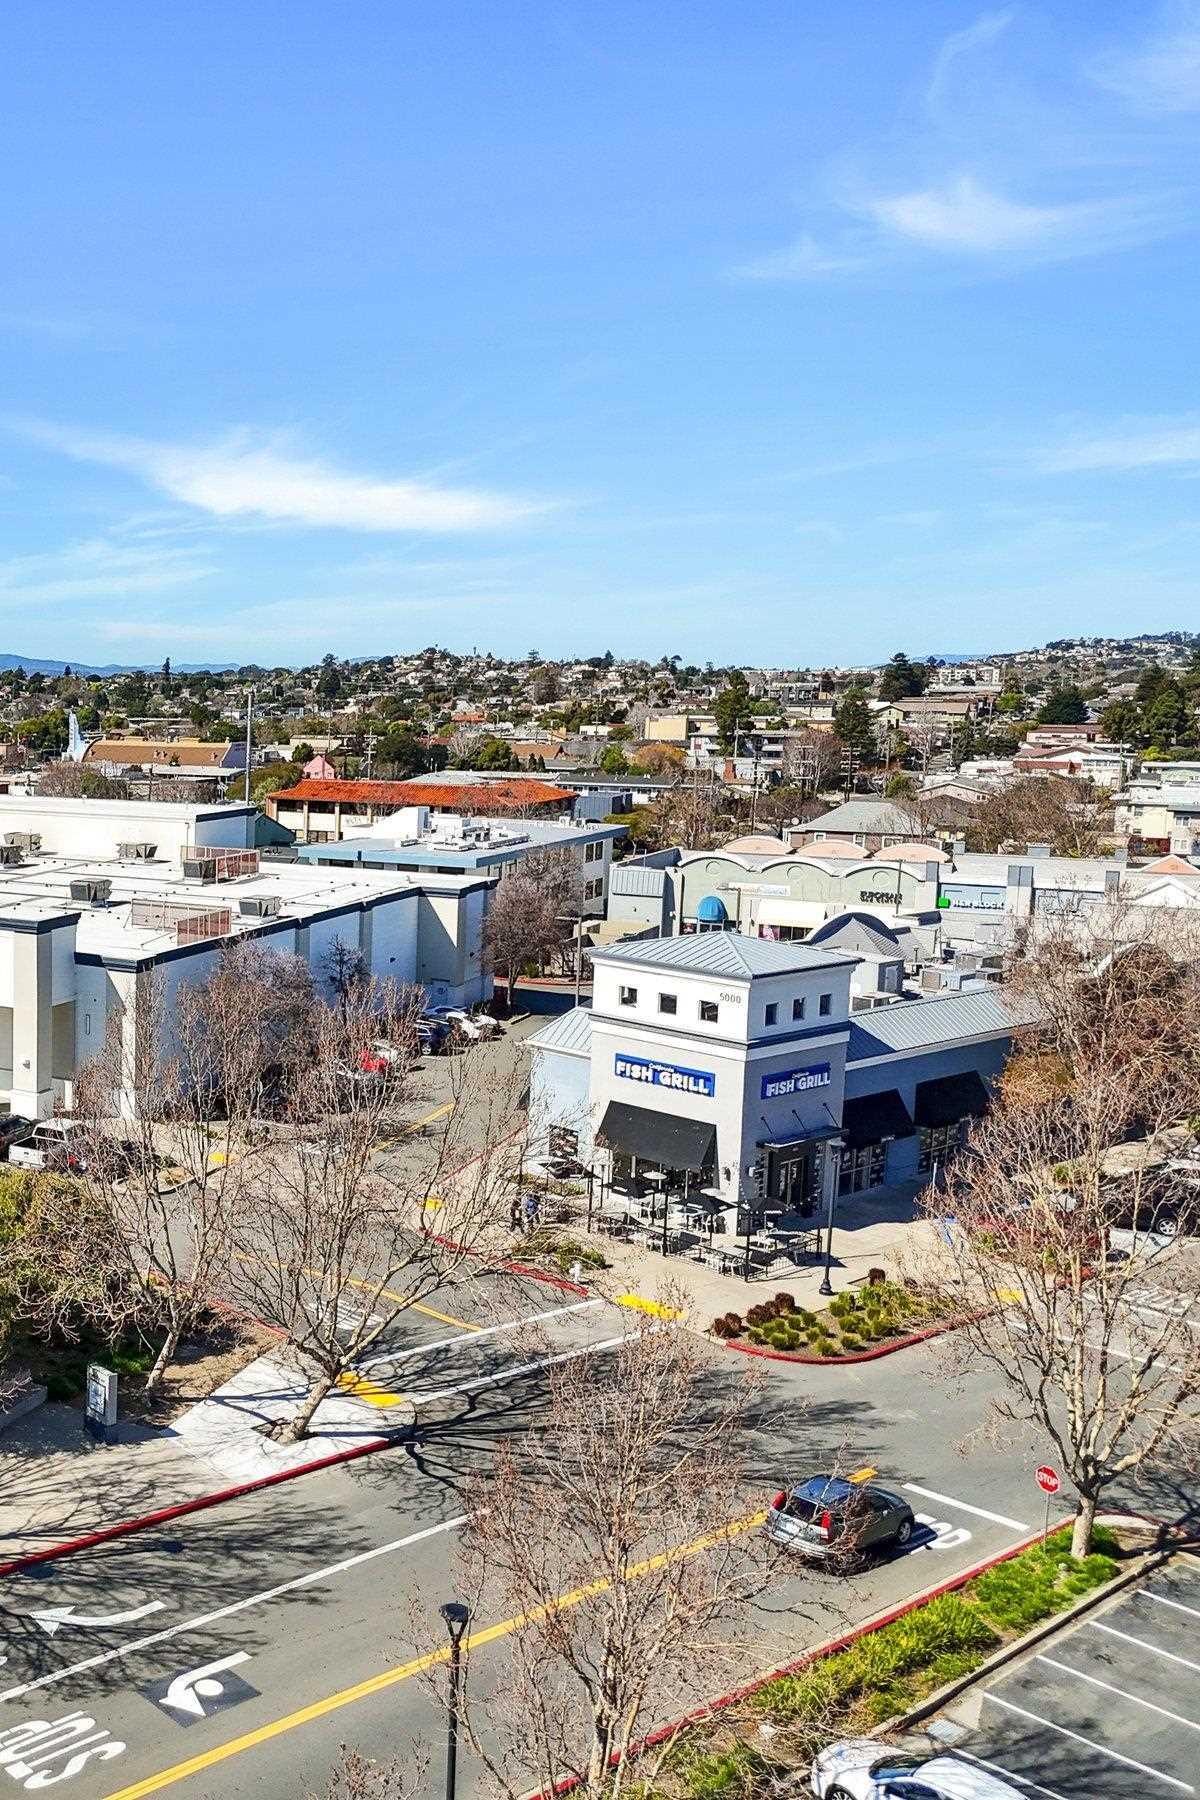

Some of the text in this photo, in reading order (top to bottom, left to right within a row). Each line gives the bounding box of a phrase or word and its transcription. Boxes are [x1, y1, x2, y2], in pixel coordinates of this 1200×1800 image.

[719, 992, 742, 1004] 5000
[616, 1061, 710, 1094] FISH GRILL
[766, 1072, 831, 1097] FISH GRILL
[1038, 1471, 1059, 1486] STOP
